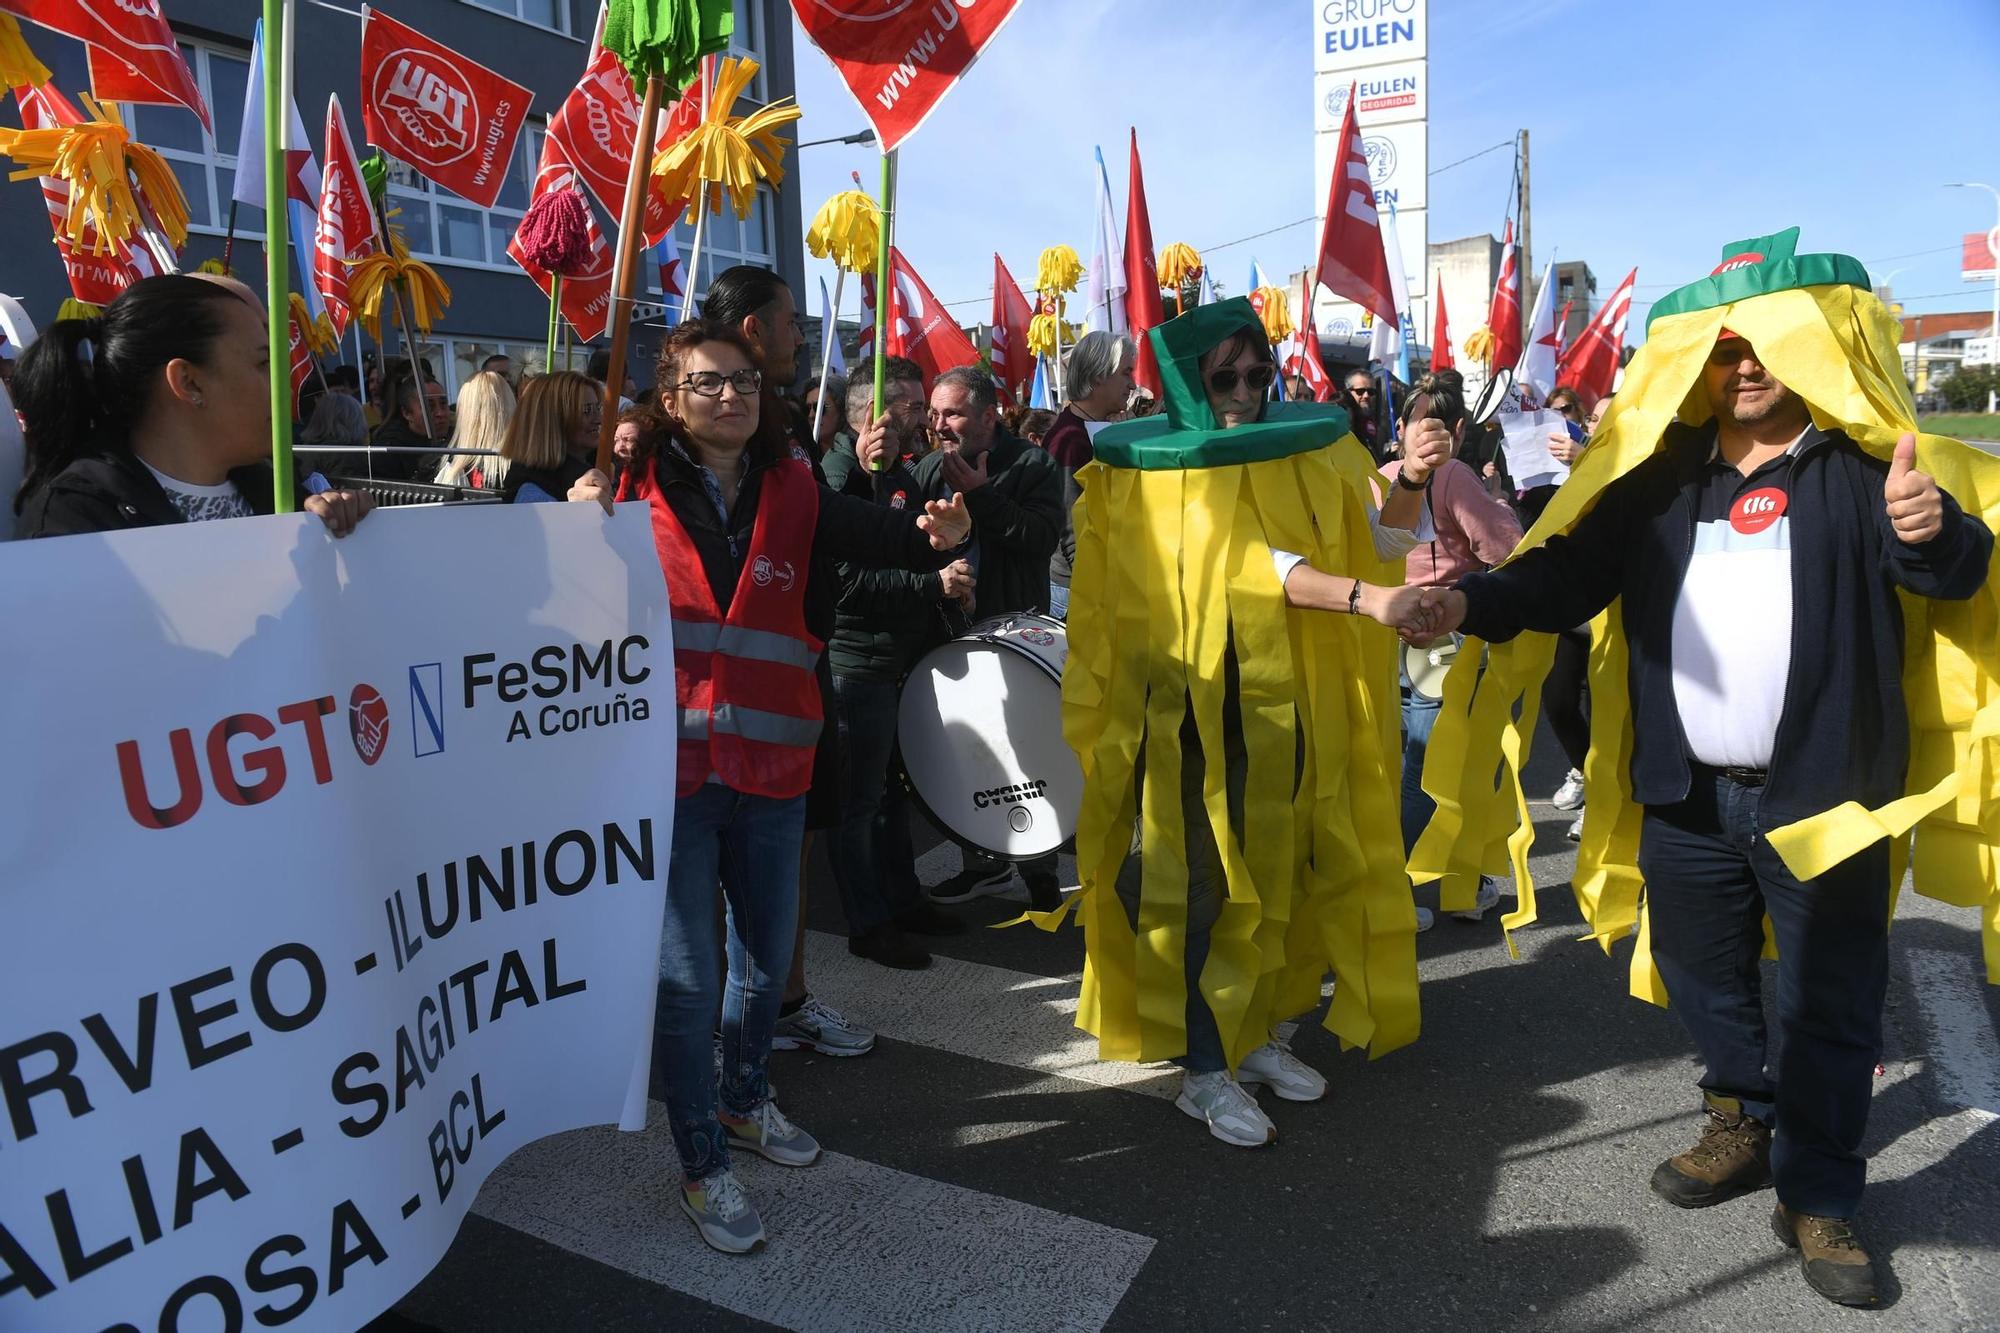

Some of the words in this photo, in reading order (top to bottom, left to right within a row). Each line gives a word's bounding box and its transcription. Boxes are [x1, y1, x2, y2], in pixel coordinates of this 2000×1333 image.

[1323, 0, 1415, 24] GRUPO
[1325, 19, 1413, 54] EULEN
[390, 57, 468, 132] UGT
[1360, 77, 1415, 97] EULEN
[1360, 95, 1416, 111] SEGURIDAD
[473, 99, 511, 186] www.ugt.es
[1743, 496, 1776, 515] CIG
[463, 634, 651, 709] FeSMC
[506, 710, 532, 743] A
[538, 697, 650, 737] Coruña
[116, 694, 336, 830] UGT
[0, 942, 327, 1143] RVEO
[384, 818, 655, 974] ILUNION
[331, 937, 587, 1139] SAGITAL
[98, 1198, 390, 1333] OSA
[427, 1072, 506, 1206] BCL
